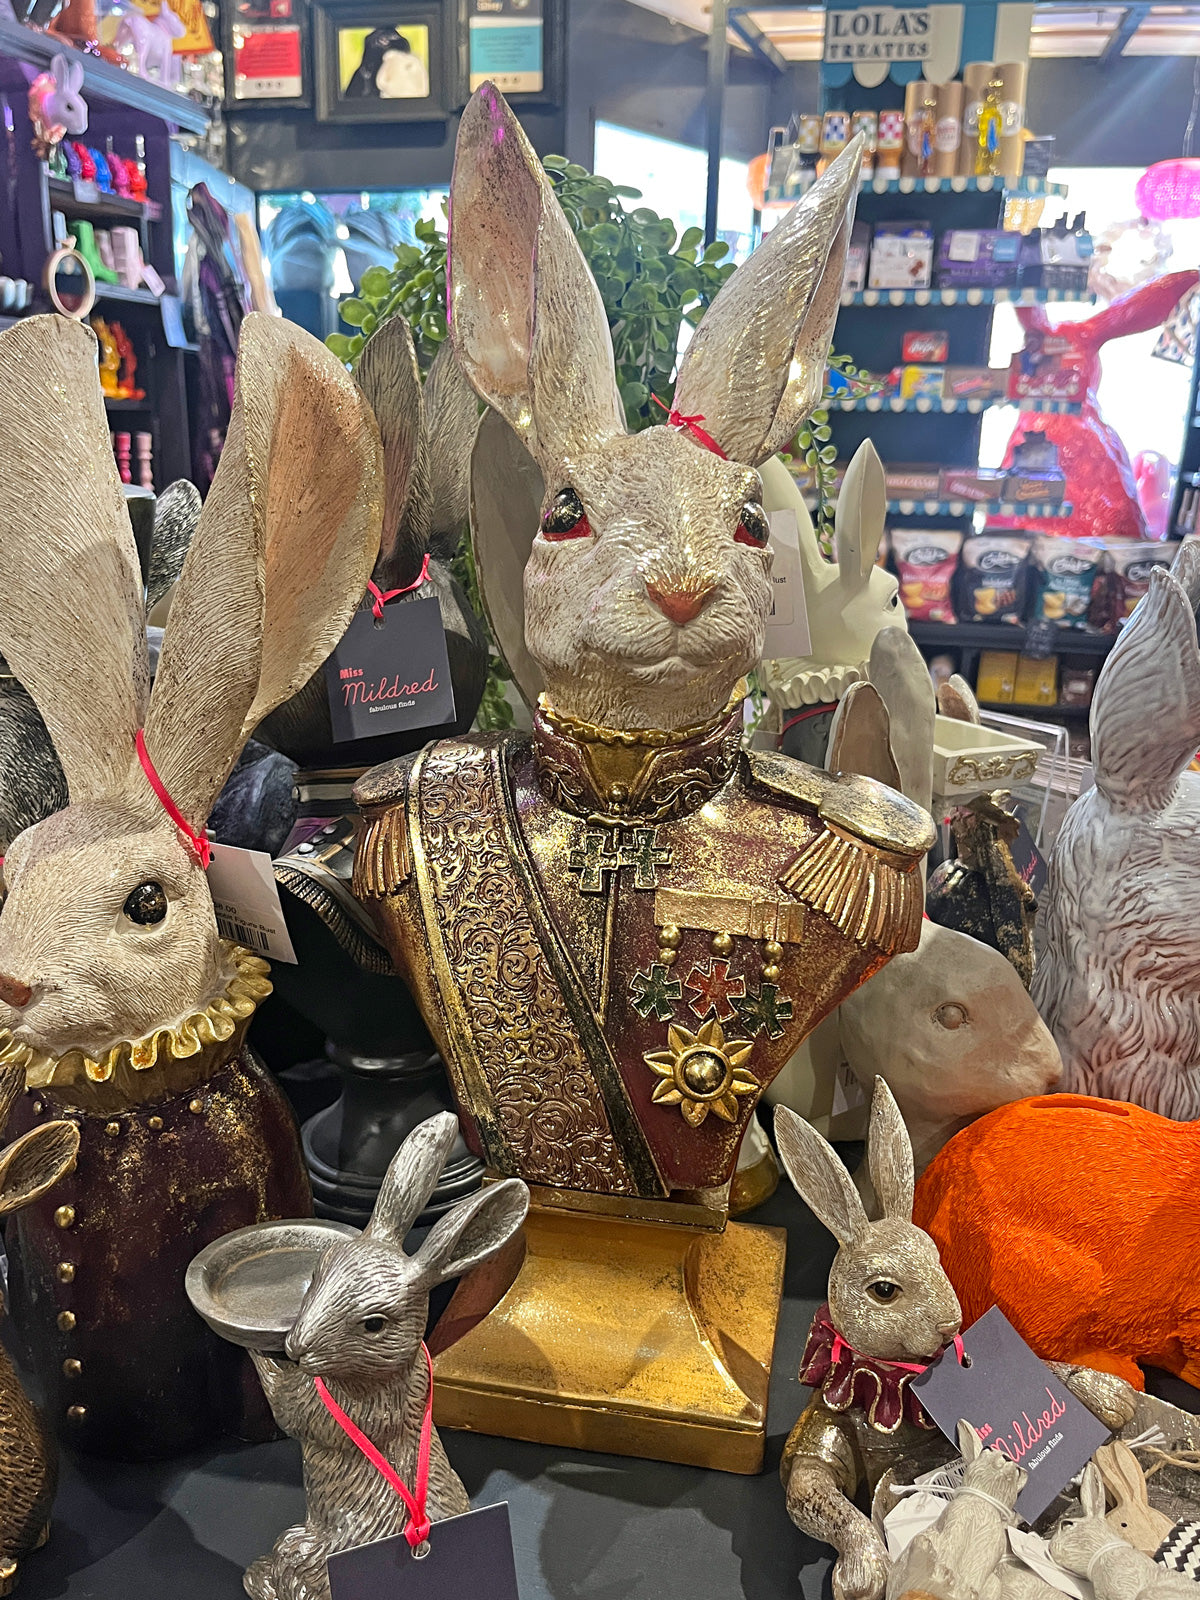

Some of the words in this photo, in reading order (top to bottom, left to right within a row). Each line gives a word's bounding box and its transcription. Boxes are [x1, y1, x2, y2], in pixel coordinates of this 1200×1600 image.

[832, 12, 929, 36] LOLA'S
[830, 43, 928, 58] TREATIES
[339, 667, 364, 680] Miss
[341, 668, 439, 706] Mildred
[369, 704, 397, 713] fabulous
[398, 700, 415, 708] finds
[975, 1423, 993, 1440] iss
[1028, 1445, 1052, 1470] fabulous
[1048, 1432, 1064, 1448] finds
